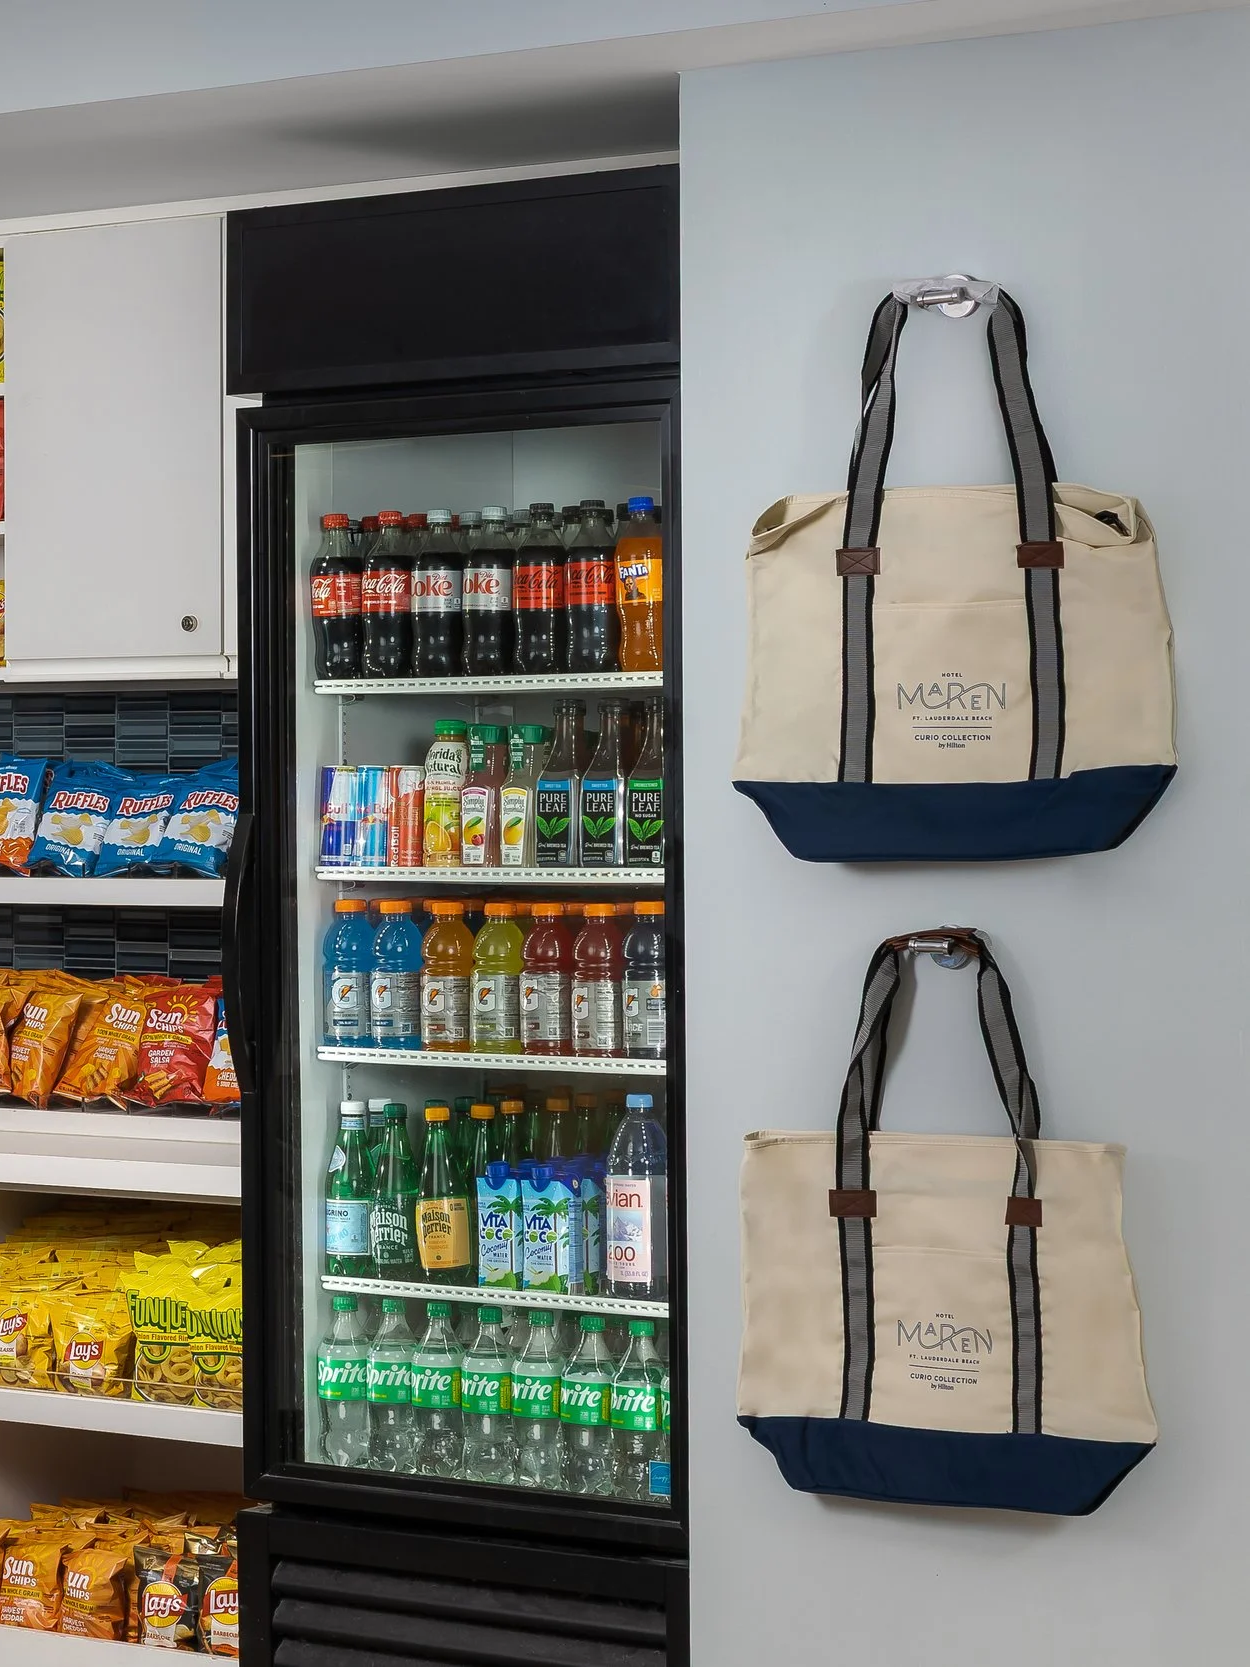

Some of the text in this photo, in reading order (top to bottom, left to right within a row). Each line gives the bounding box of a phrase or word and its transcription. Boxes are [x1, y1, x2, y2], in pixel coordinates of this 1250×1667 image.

[432, 573, 448, 582] Diet
[619, 564, 648, 579] FANTA
[898, 682, 1006, 710] MAREN
[50, 791, 110, 812] RUFFLES
[117, 794, 174, 816] RUFFLES
[180, 791, 239, 812] RUFFLES
[540, 794, 566, 802] PURE
[586, 793, 614, 802] PURE
[632, 793, 660, 802] PURE
[174, 842, 202, 856] ORIGINAL
[106, 1004, 141, 1024] Sun
[147, 1008, 183, 1028] Sun
[113, 1020, 138, 1032] CHIPS
[156, 1022, 183, 1034] CHIPS
[422, 1210, 450, 1224] Maison
[480, 1214, 508, 1228] VITA
[524, 1215, 552, 1230] VITA
[423, 1222, 452, 1238] Perrier
[481, 1240, 508, 1256] Coconut
[526, 1243, 552, 1260] Coconut
[898, 1320, 992, 1354] MAREN
[70, 1343, 101, 1360] Lay's
[921, 1355, 959, 1363] LAUDERDALE
[318, 1360, 367, 1386] Sprite
[910, 1373, 978, 1384] CURIO COLLECTION
[3, 1556, 34, 1580] Sun
[10, 1576, 37, 1587] CHIPS
[68, 1571, 90, 1590] un
[24, 1590, 40, 1598] GRAIN
[1, 1606, 25, 1616] HARVEST
[144, 1592, 182, 1618] Lay's
[1, 1614, 24, 1623] CHEDDAR
